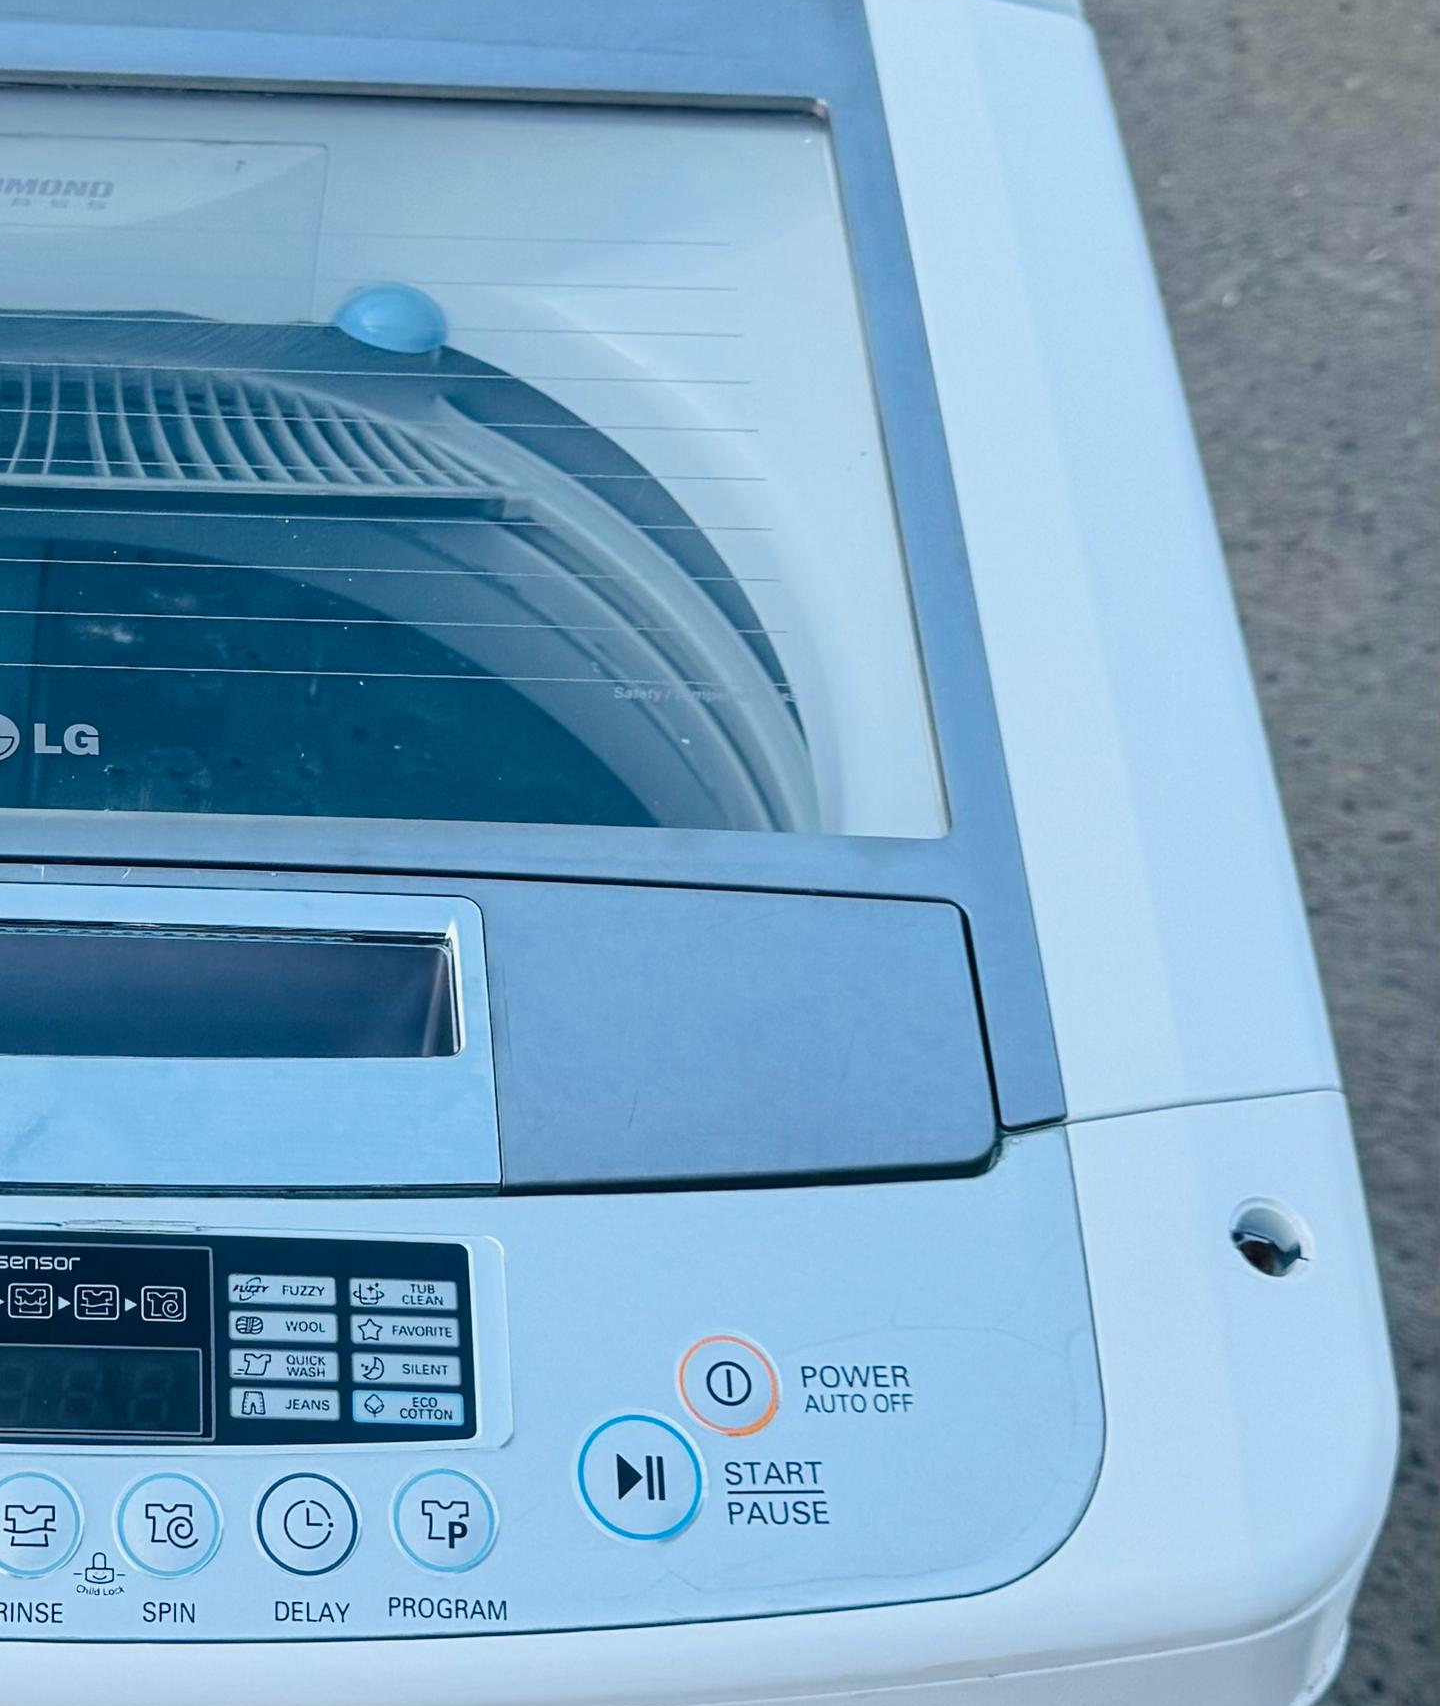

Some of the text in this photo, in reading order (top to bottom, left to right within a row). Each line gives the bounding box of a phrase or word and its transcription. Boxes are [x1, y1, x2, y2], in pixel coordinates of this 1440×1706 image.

[34, 723, 100, 755] LG
[282, 1284, 325, 1297] FUZZY
[411, 1283, 435, 1294] TUB
[402, 1295, 443, 1306] CLEAN
[285, 1321, 326, 1333] WOOL
[392, 1325, 453, 1338] FAVORITE
[286, 1355, 326, 1366] QUICK
[286, 1367, 325, 1378] WASH
[402, 1363, 448, 1376] SILENT
[801, 1365, 911, 1388] POWER
[285, 1398, 330, 1411] JEANS
[412, 1397, 438, 1408] ECO
[805, 1394, 914, 1413] AUTO OFF
[399, 1408, 453, 1421] COTTON
[724, 1461, 823, 1485] START
[728, 1501, 830, 1525] PAUSE
[76, 1584, 100, 1596] Child
[142, 1601, 196, 1623] SPIN
[274, 1601, 350, 1623] DELAY
[388, 1597, 507, 1621] PROGRAM
